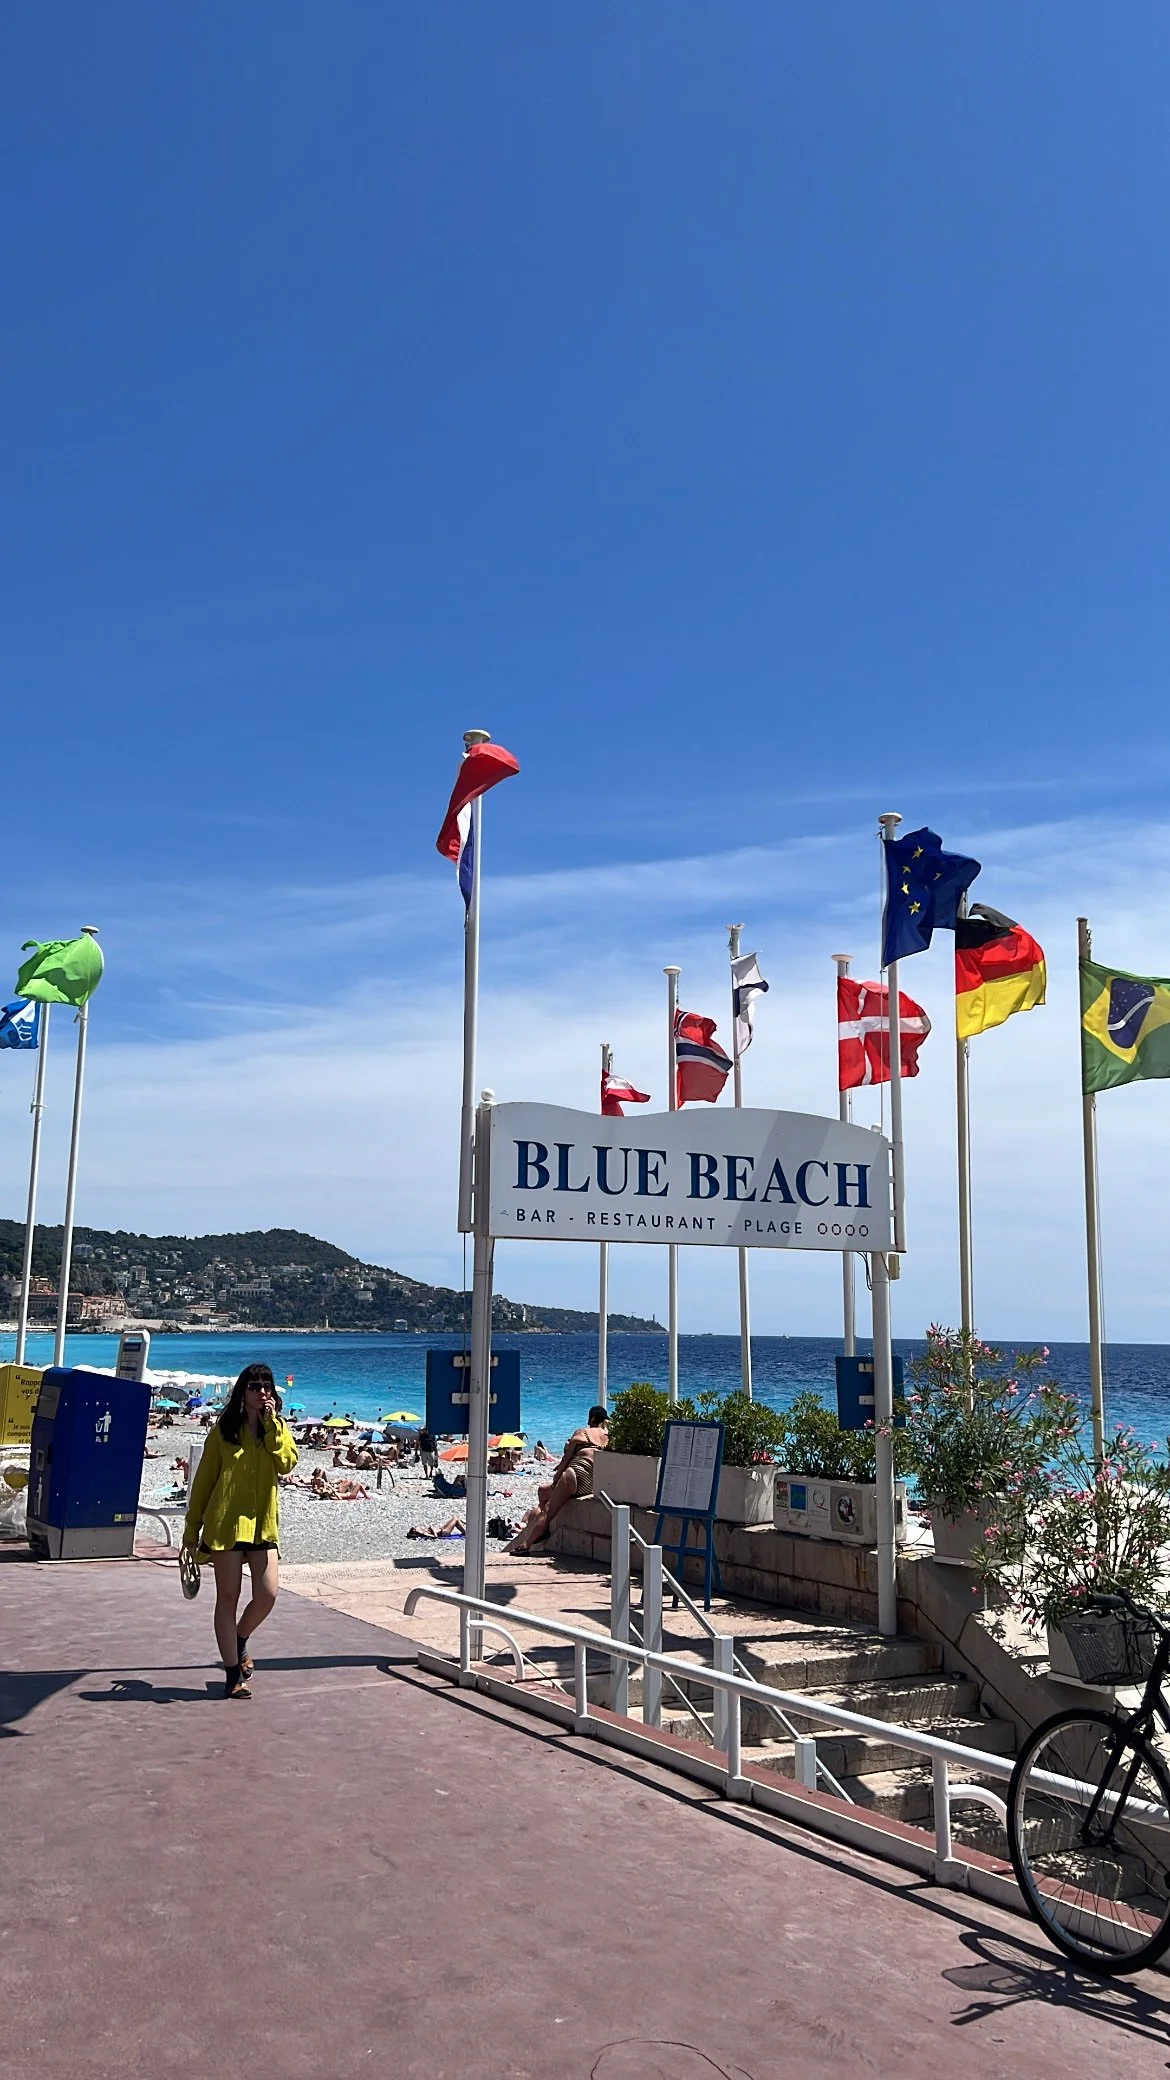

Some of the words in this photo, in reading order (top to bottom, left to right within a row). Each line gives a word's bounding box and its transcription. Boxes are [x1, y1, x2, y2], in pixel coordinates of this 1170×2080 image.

[512, 1139, 669, 1197] BLUE
[685, 1152, 873, 1208] BEACH
[516, 1208, 556, 1223] BAR
[587, 1211, 716, 1230] RESTAURANT
[744, 1219, 803, 1235] PLAGE
